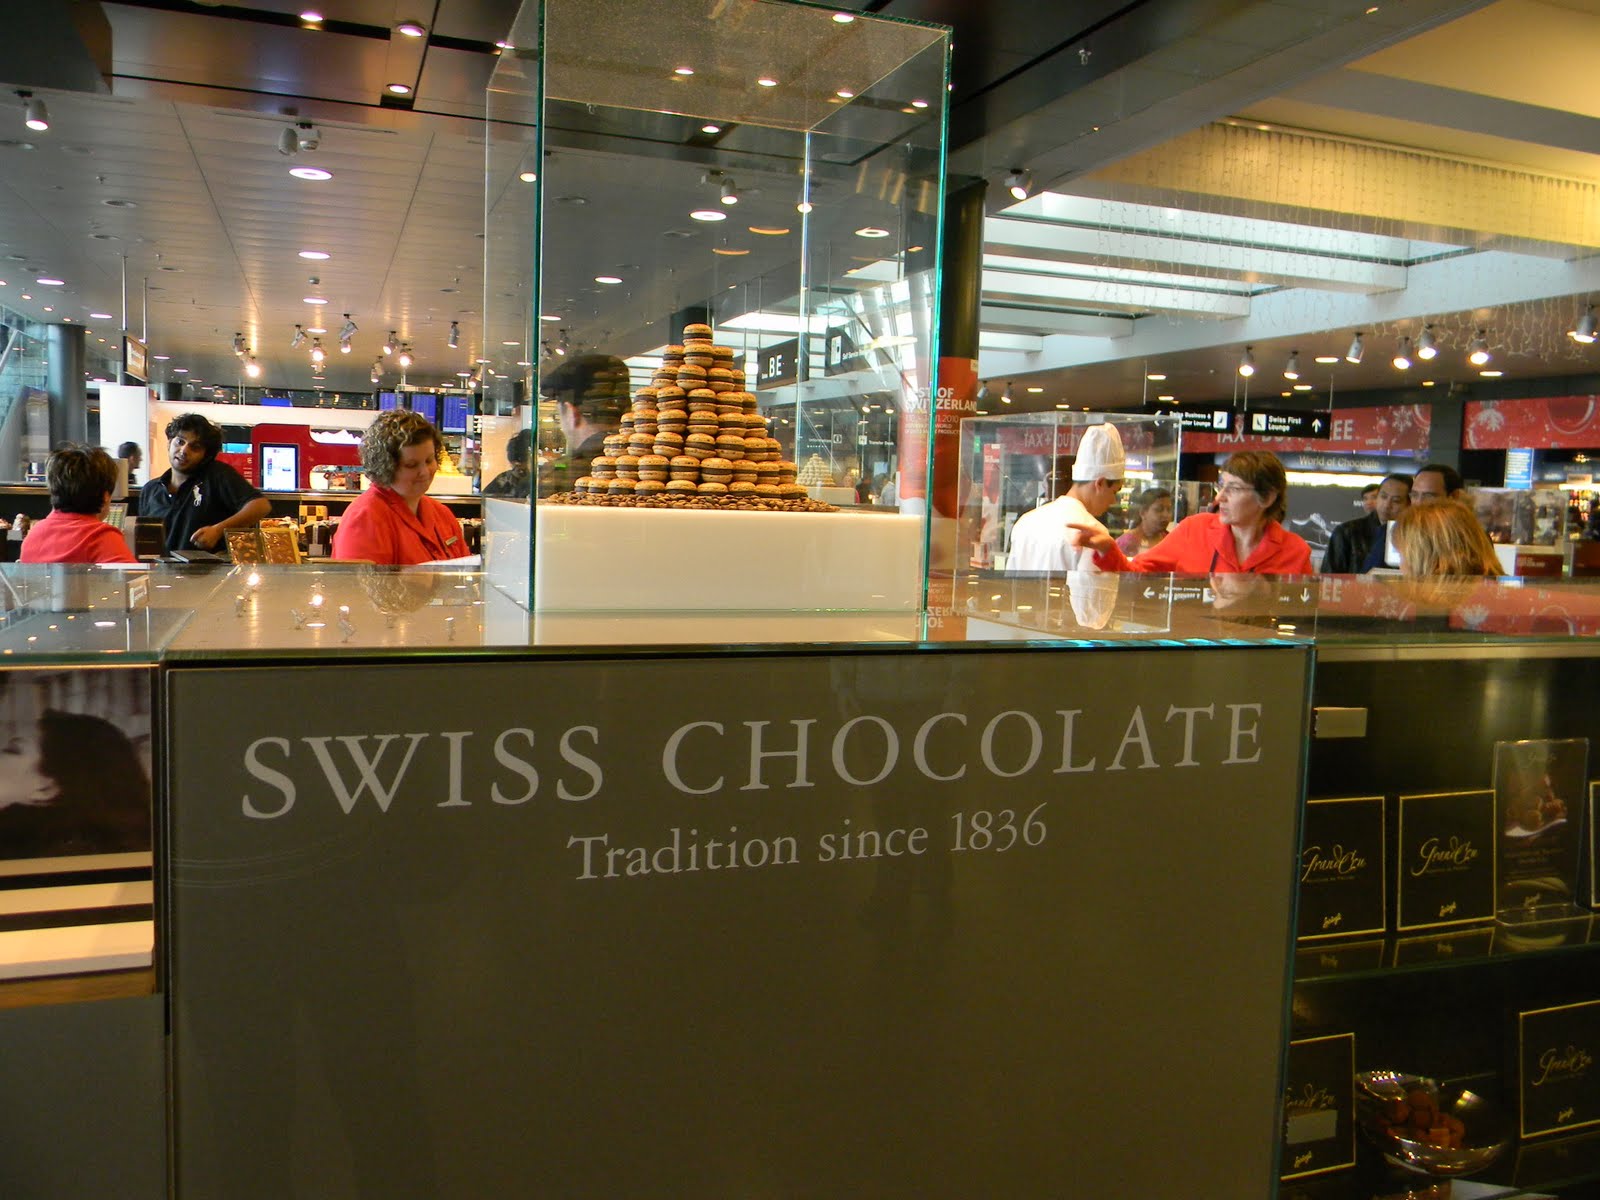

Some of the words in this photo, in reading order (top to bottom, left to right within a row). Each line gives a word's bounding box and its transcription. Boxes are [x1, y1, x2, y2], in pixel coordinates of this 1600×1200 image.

[937, 387, 954, 399] OF
[1269, 415, 1286, 423] Swiss
[1287, 416, 1302, 424] First
[1268, 423, 1290, 432] Lounge
[1330, 419, 1354, 441] EE
[1024, 434, 1042, 448] TAX
[1300, 455, 1325, 467] World
[1327, 457, 1335, 467] of
[1338, 457, 1380, 469] Chocolate
[241, 724, 604, 820] SWISS
[661, 702, 1263, 795] CHOCOLATE
[566, 825, 800, 881] Tradition
[818, 818, 929, 863] since
[949, 802, 1048, 853] 1836
